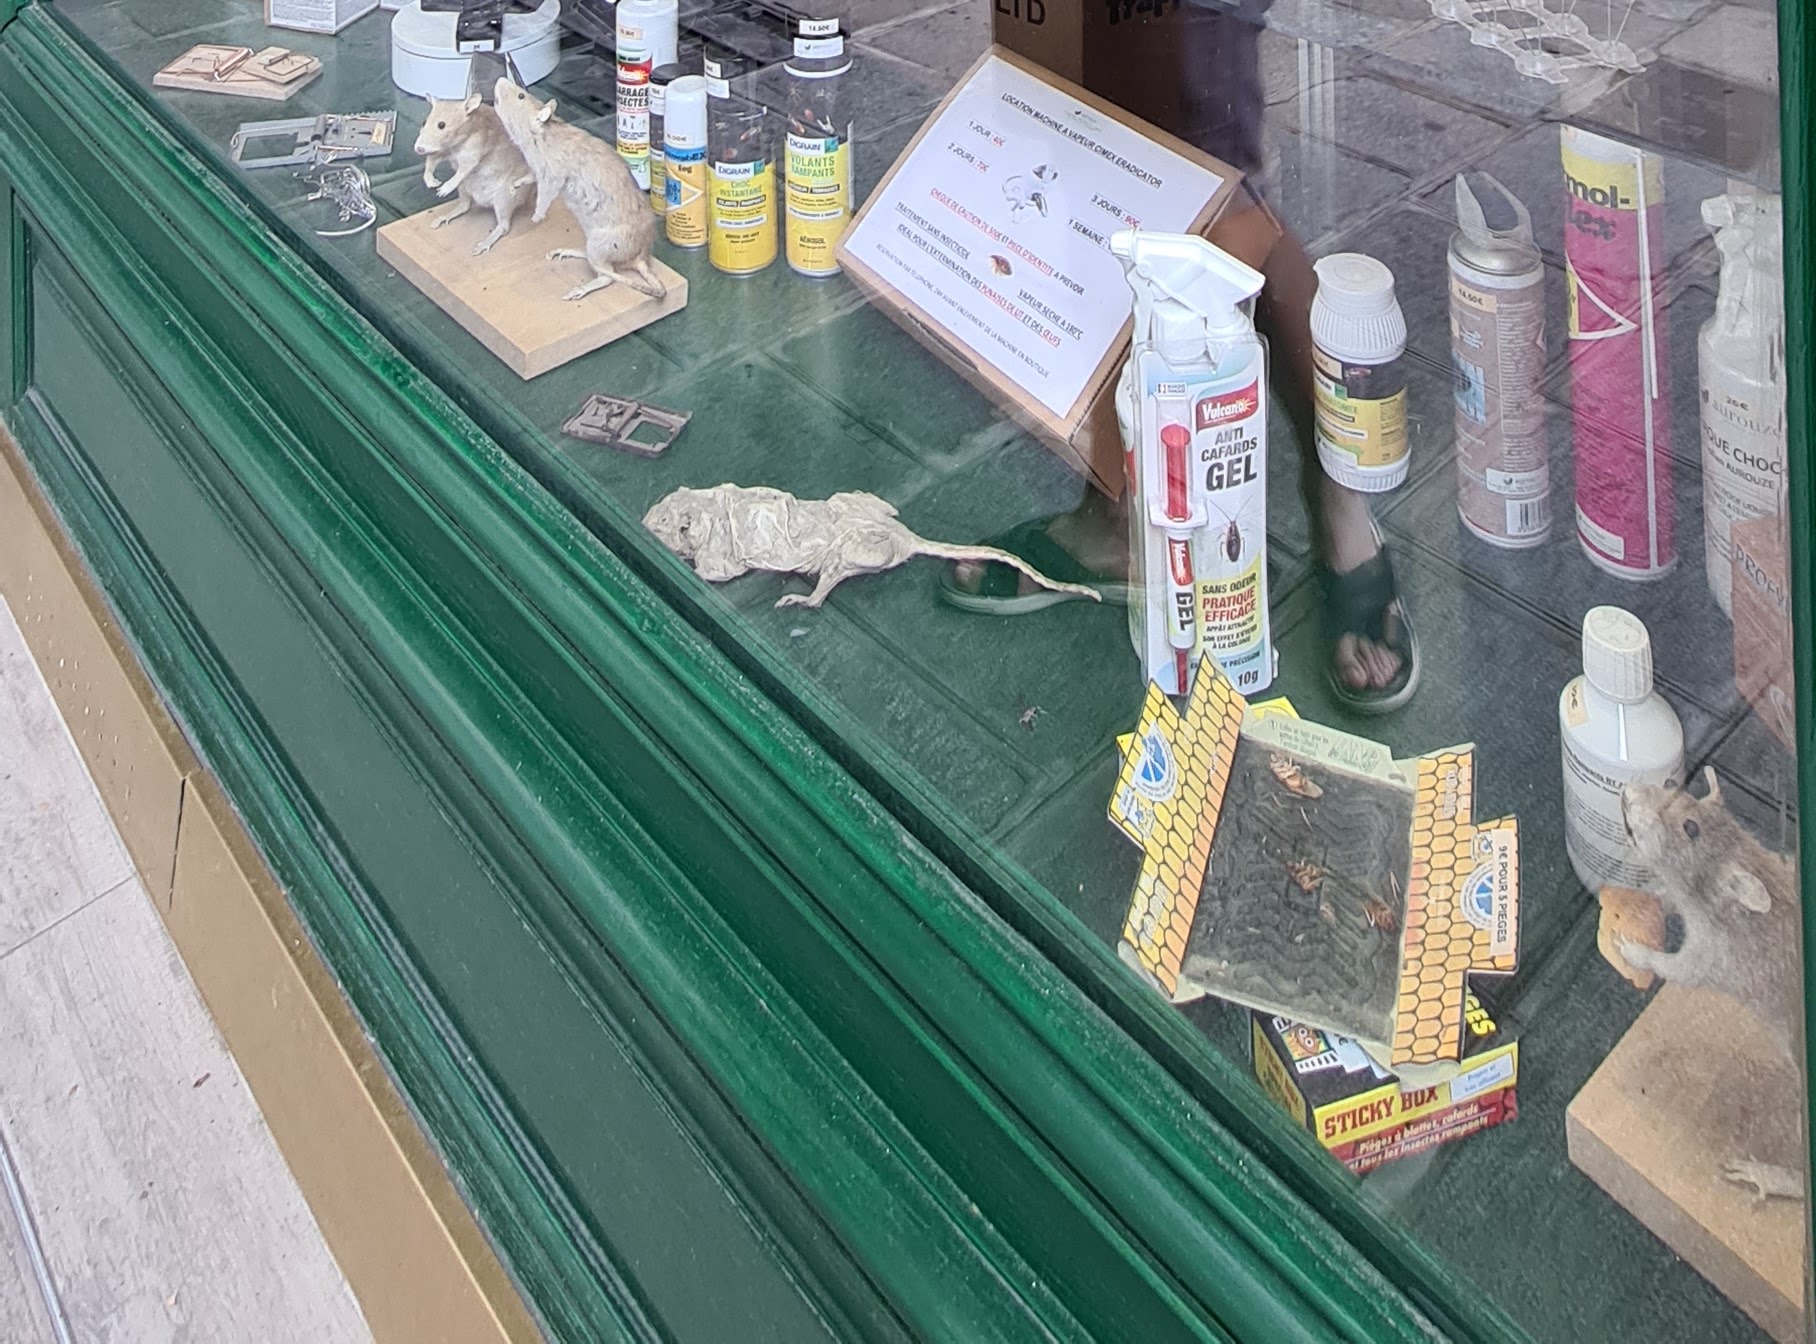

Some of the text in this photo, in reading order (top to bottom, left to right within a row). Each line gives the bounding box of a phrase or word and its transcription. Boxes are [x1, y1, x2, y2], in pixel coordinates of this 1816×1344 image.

[972, 123, 992, 138] JOUR
[1001, 92, 1034, 115] LOCATION
[1034, 110, 1064, 134] MACHINE
[1068, 128, 1096, 150] VAPEUR
[1094, 144, 1118, 162] CIMEX
[1116, 156, 1164, 188] ERADICATOR
[791, 155, 835, 168] VOLANTS
[954, 145, 975, 164] JOURS
[1091, 194, 1098, 203] 3
[1097, 196, 1122, 217] JOURS
[896, 202, 928, 227] TRAITEMENT
[927, 222, 941, 237] SANS
[1072, 220, 1104, 245] SEMAINE
[912, 233, 928, 249] POUR
[970, 275, 983, 290] DES
[1022, 313, 1032, 324] ET
[1030, 318, 1044, 334] DES
[1059, 274, 1085, 296] PREVOIR
[1017, 288, 1042, 311] VAPEUR
[1202, 399, 1245, 421] Vulcano
[1214, 426, 1244, 446] ANTI
[1200, 437, 1258, 462] CAFARDS
[1732, 444, 1782, 476] CHOC
[1206, 454, 1258, 492] GEL
[1726, 460, 1776, 490] AUROUZE
[1202, 572, 1257, 595] SANS ODEUR
[1202, 586, 1256, 610] PRATIQUE
[1204, 598, 1256, 623] EFFICACE
[1175, 592, 1196, 632] GEL
[1238, 670, 1259, 688] 10g
[1498, 862, 1508, 895] POUR
[1496, 904, 1508, 944] PIEGES
[1324, 1094, 1396, 1140] STICKY
[1359, 1136, 1393, 1155] Pièges
[1442, 1102, 1480, 1125] cafards
[1384, 1144, 1400, 1160] les
[1440, 1116, 1488, 1143] rampants
